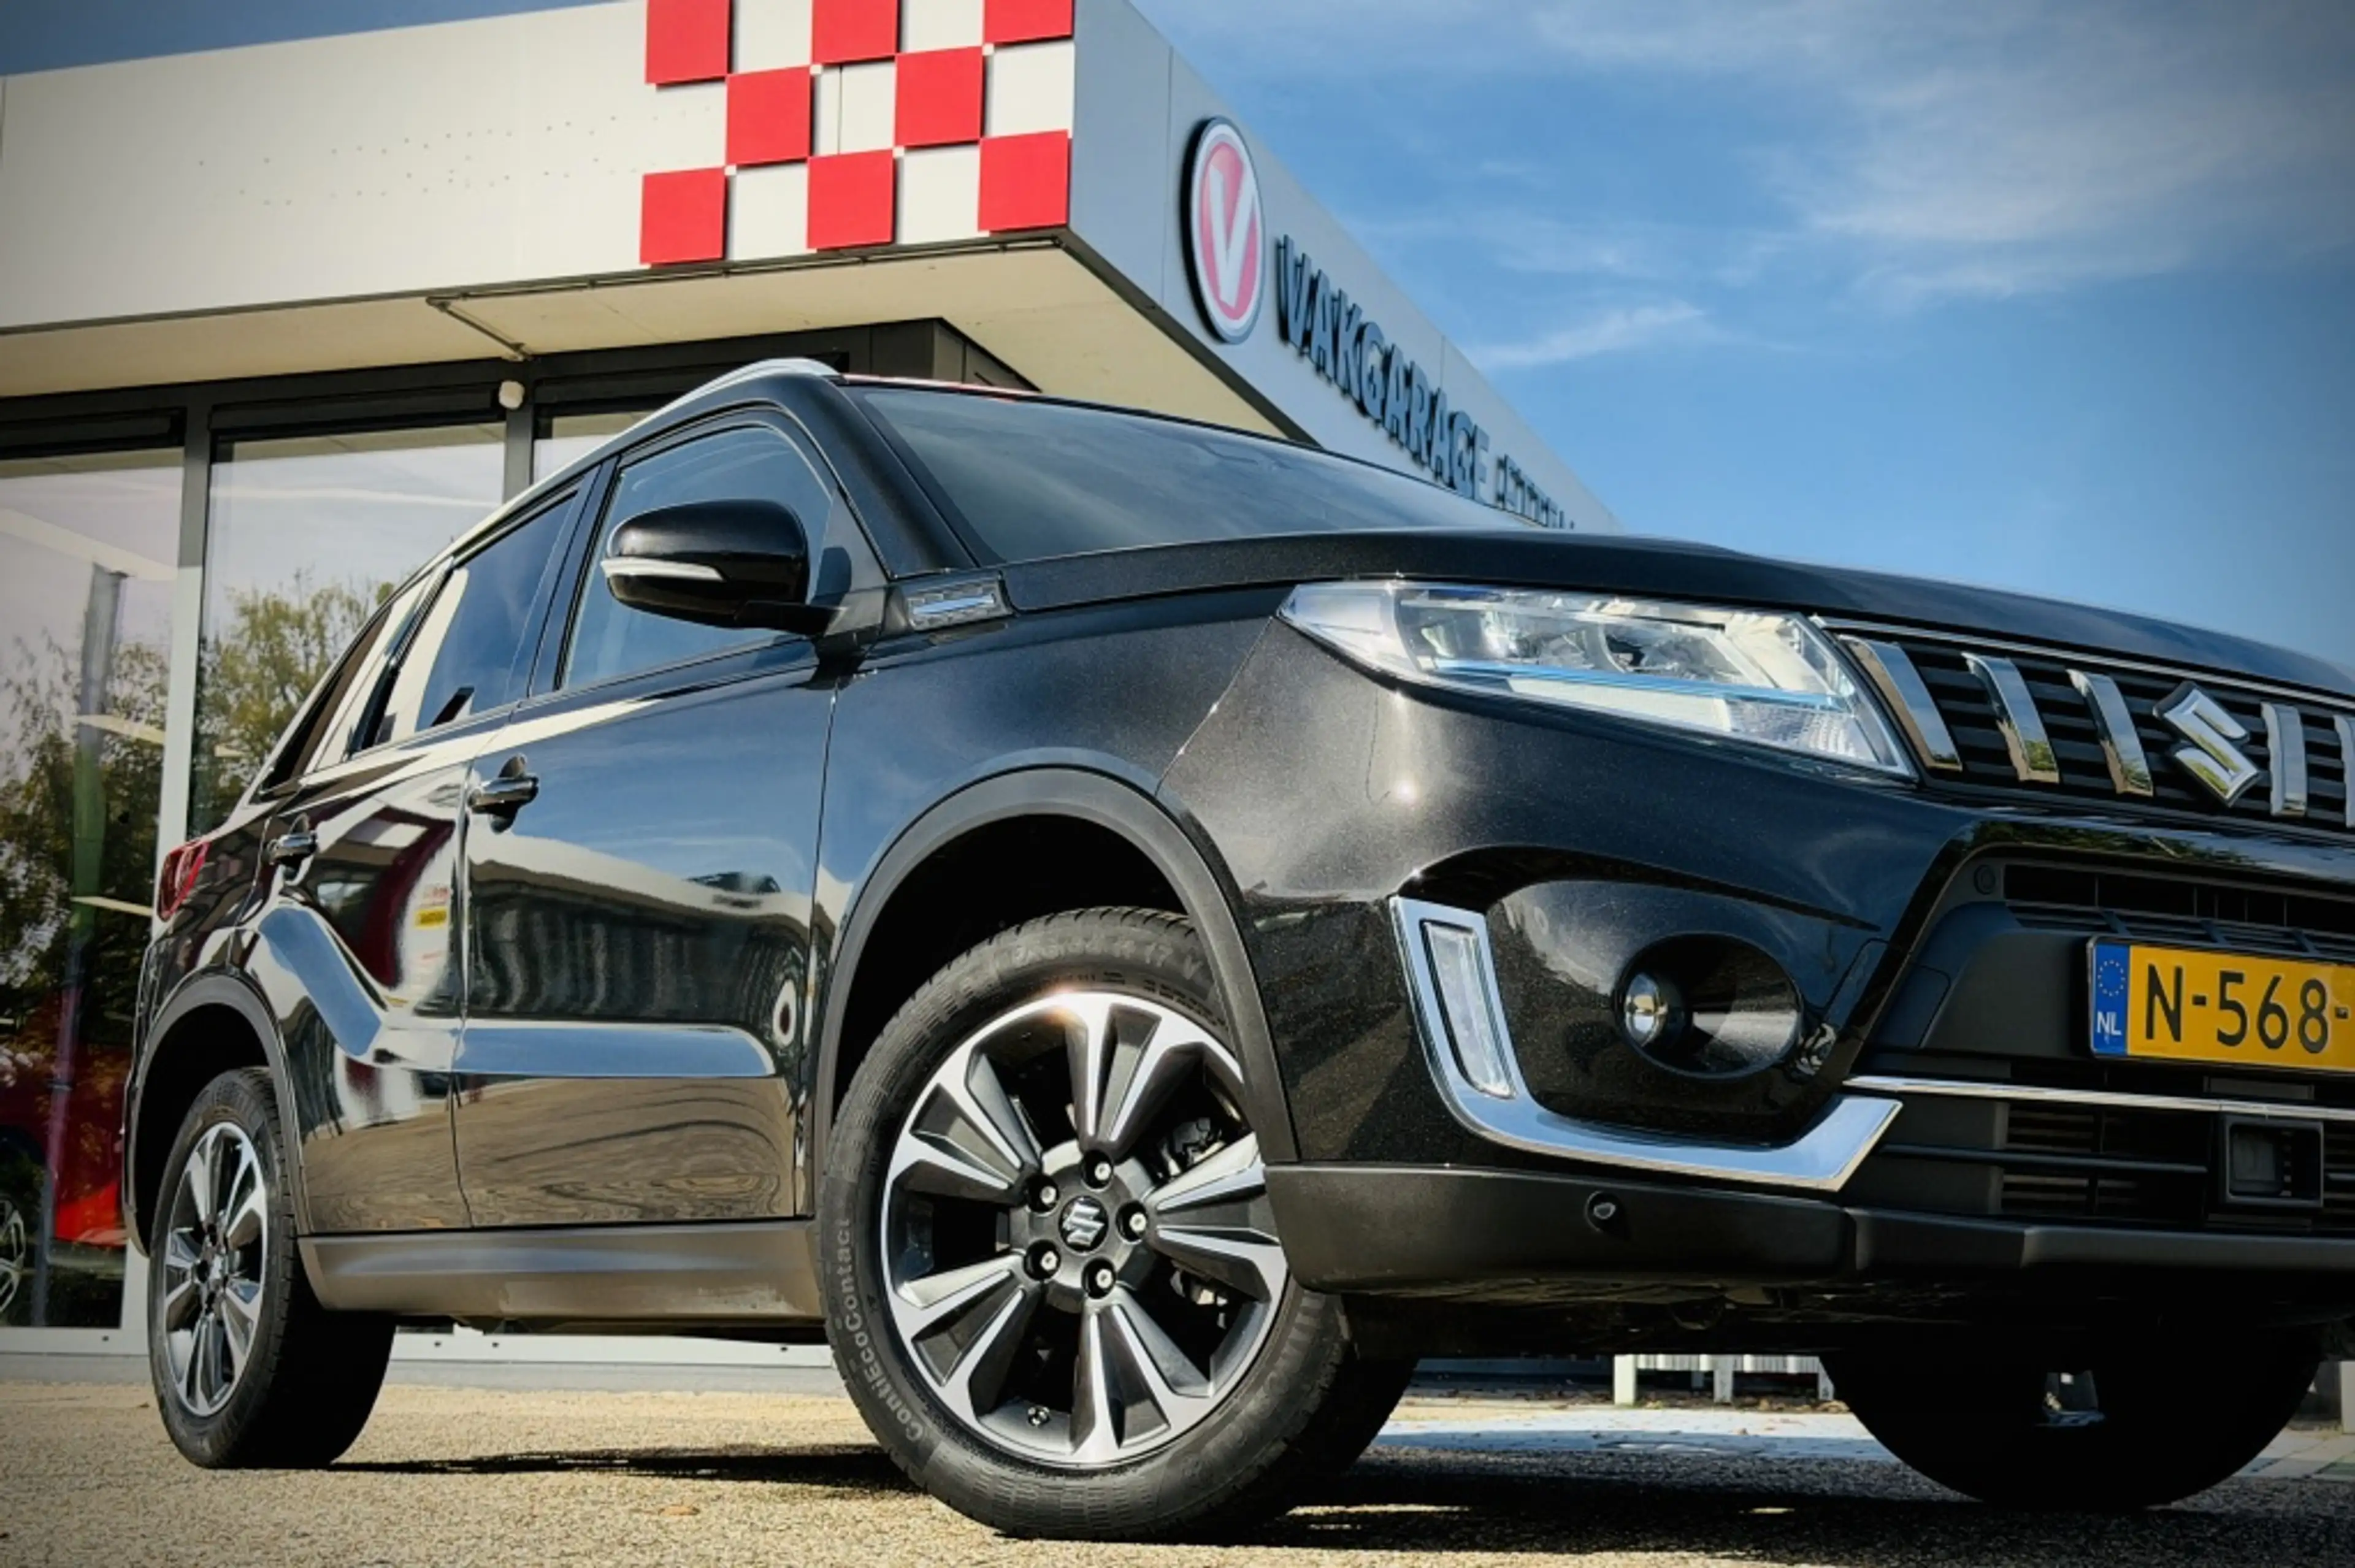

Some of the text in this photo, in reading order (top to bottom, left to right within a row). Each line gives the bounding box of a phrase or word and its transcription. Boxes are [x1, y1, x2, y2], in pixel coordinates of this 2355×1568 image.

[1276, 234, 1490, 504] VAKGARAGE
[2096, 1011, 2123, 1036] NL
[835, 1218, 924, 1442] ContiEcoContact
